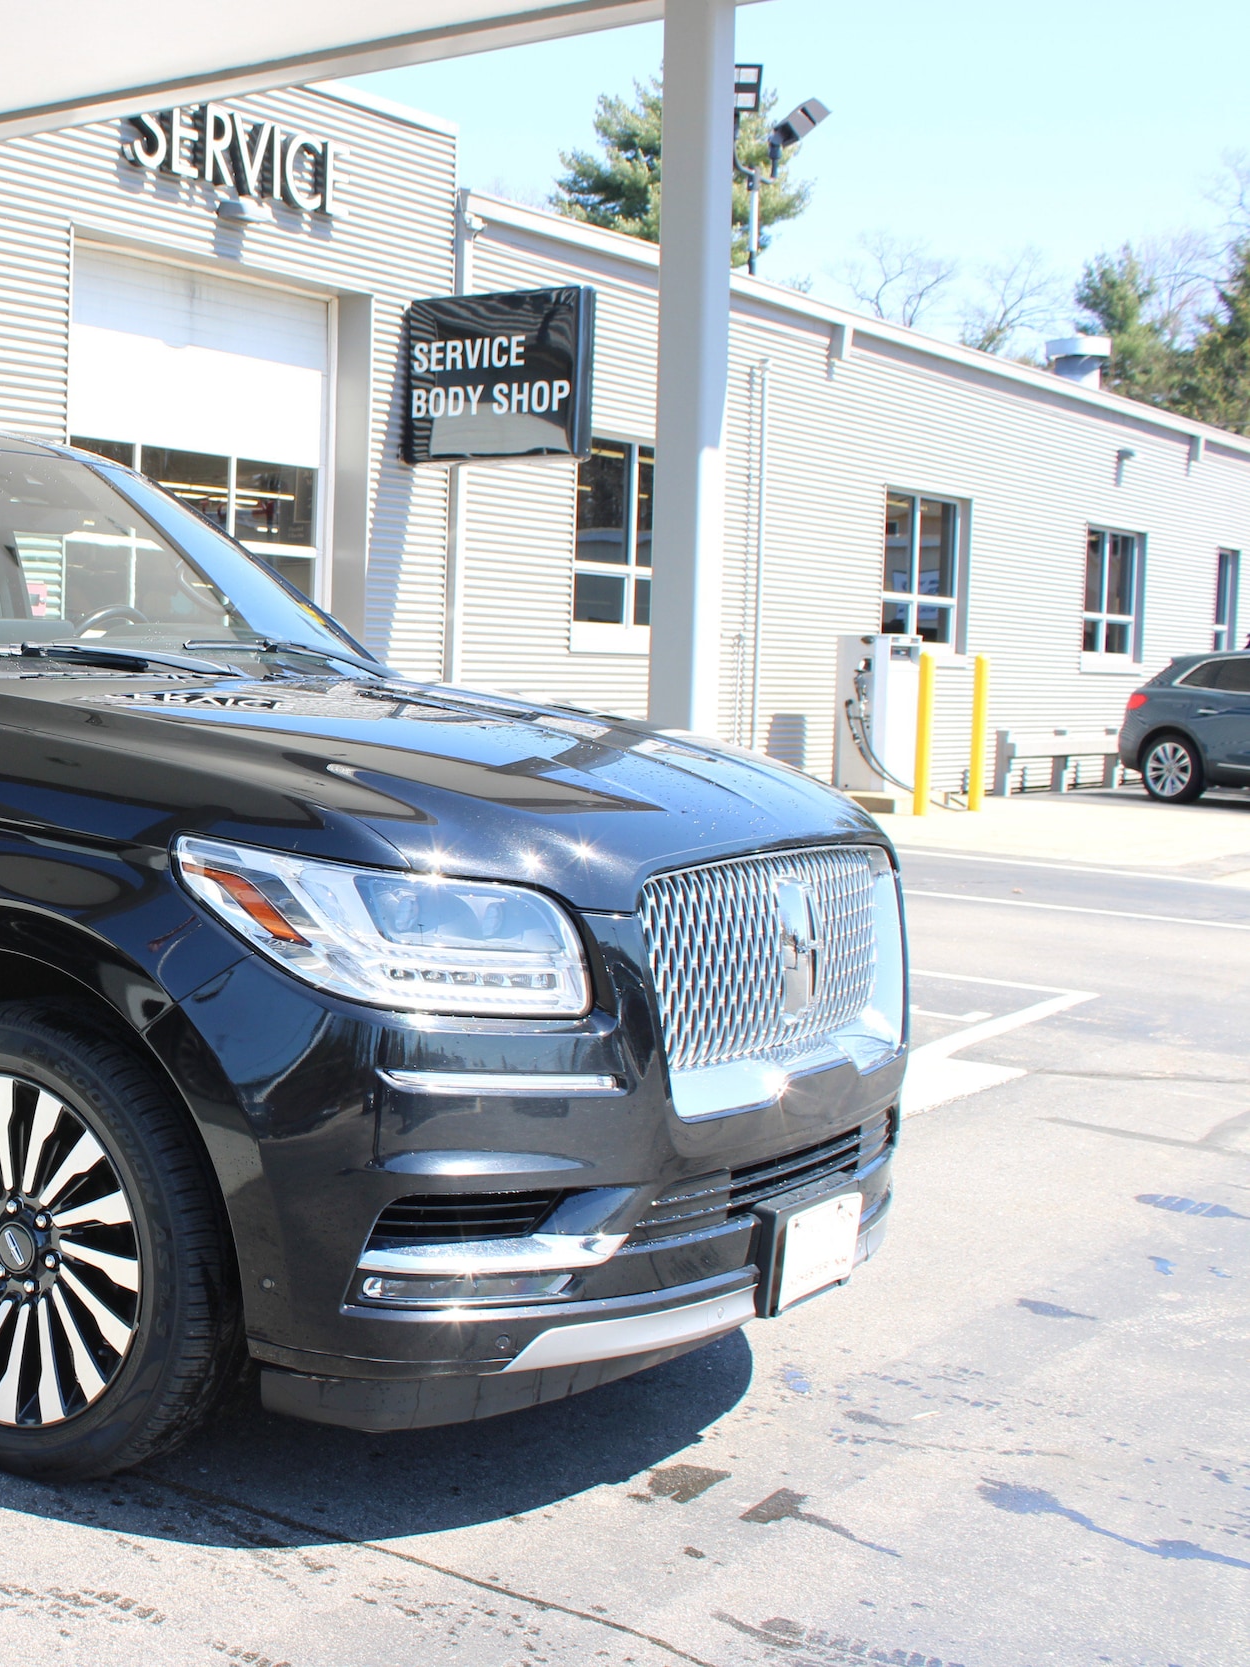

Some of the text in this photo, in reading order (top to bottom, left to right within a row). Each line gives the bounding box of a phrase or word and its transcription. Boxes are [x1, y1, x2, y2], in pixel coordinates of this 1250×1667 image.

[126, 103, 351, 217] SERVICE
[413, 334, 526, 374] SERVICE
[412, 379, 571, 419] BODY SHOP
[54, 1060, 159, 1205] SCORPION
